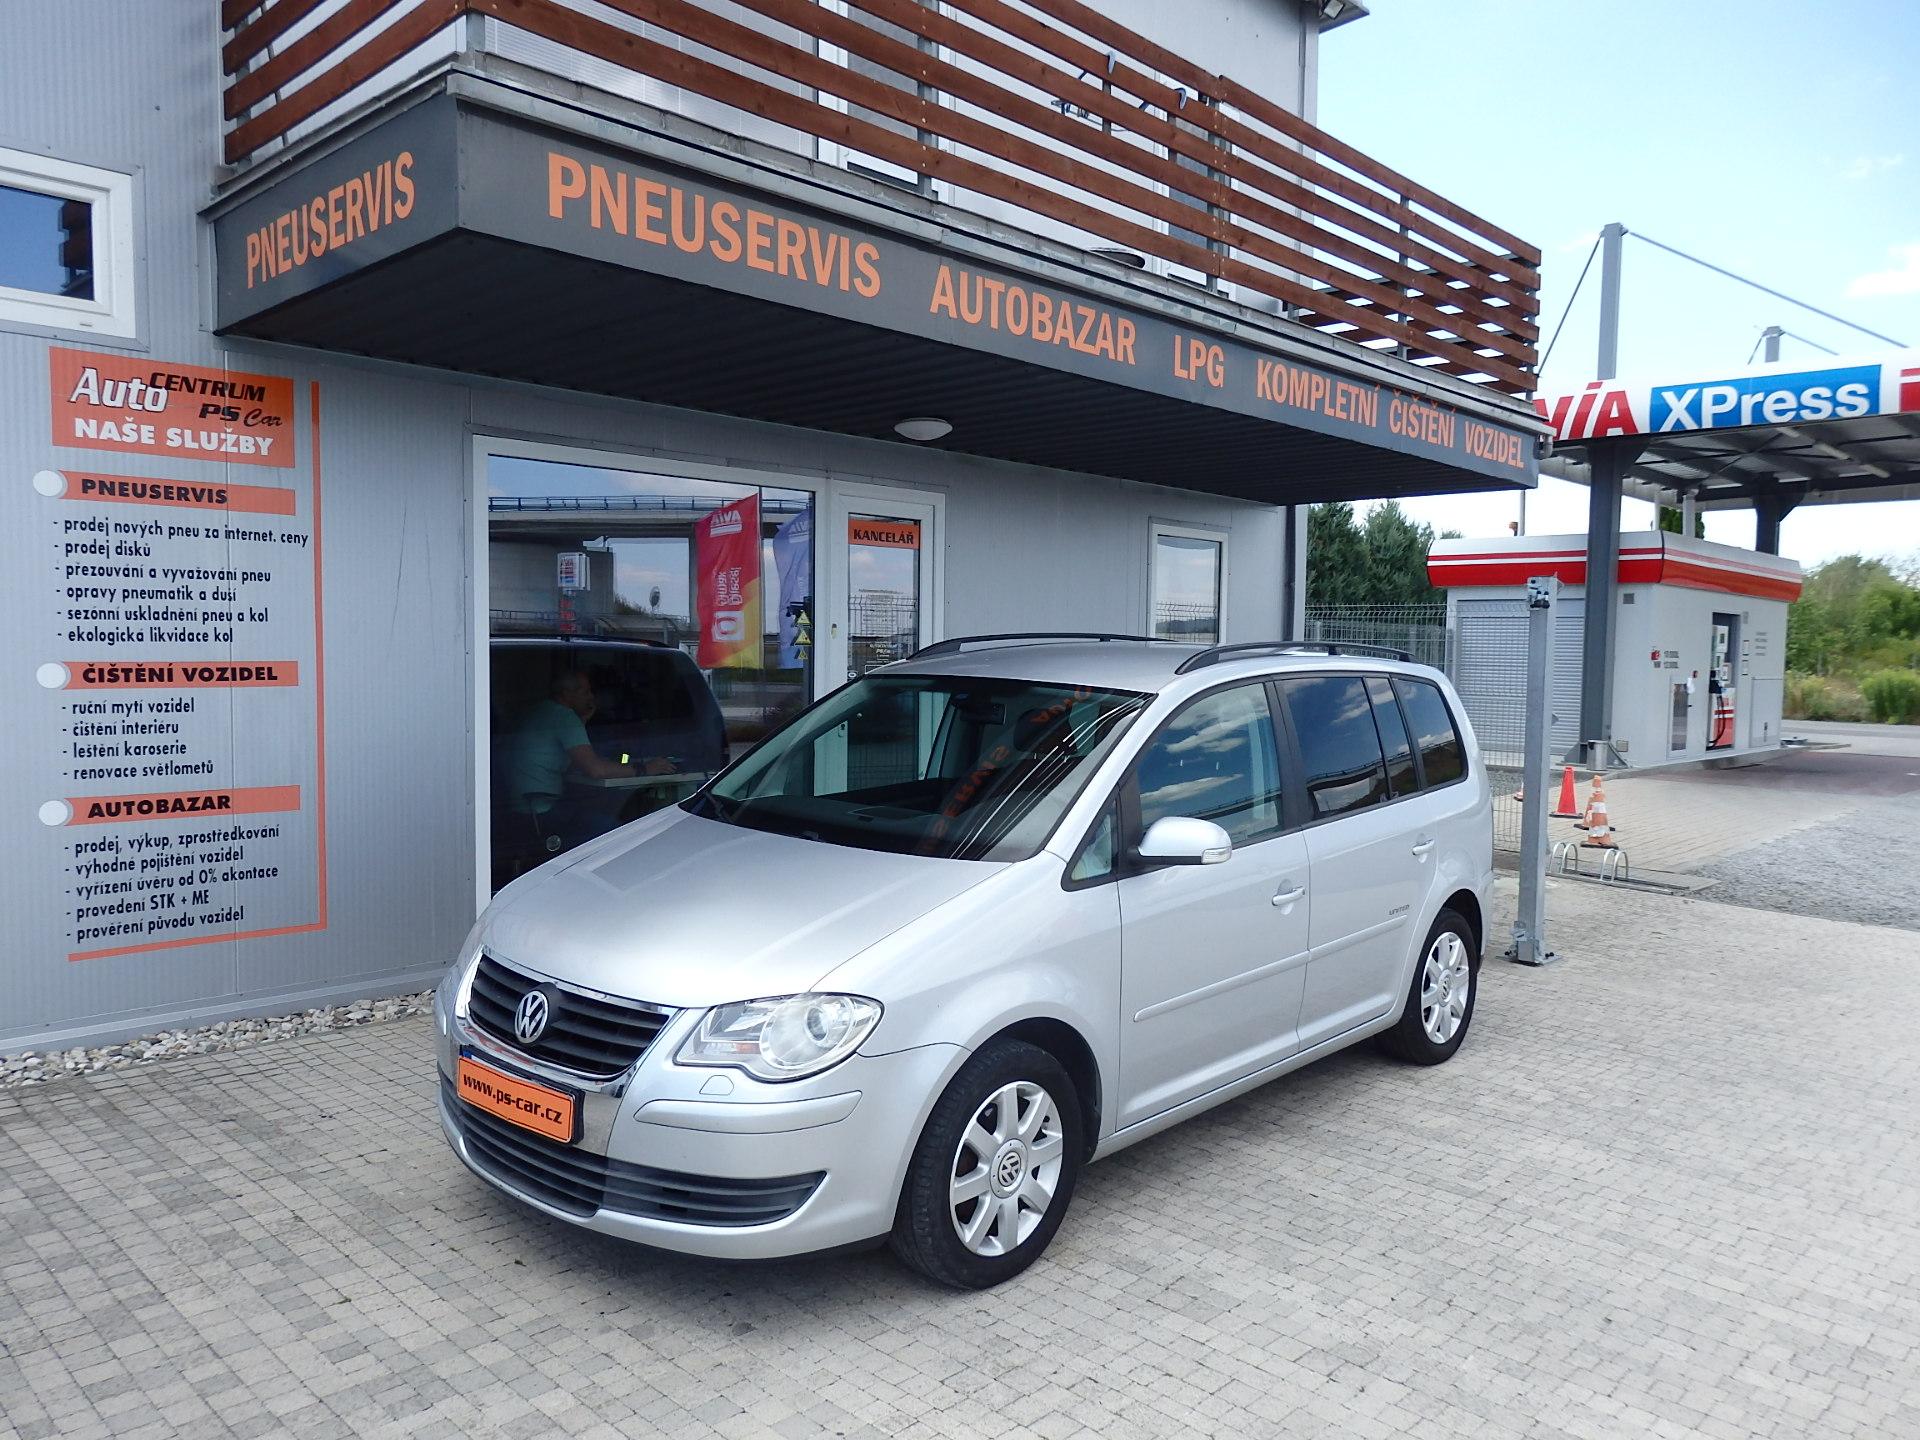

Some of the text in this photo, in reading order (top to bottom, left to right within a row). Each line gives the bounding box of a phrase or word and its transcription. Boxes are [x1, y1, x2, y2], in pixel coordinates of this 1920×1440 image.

[246, 151, 415, 289] PNEUSERVIS
[548, 152, 1524, 468] PNEUSERVIS AUTOBAZAR LPG KOMPLETNÍ ČIŠTĚNÍ VOZIDEL
[68, 366, 266, 413] Auto CENTRUM
[198, 403, 283, 427] PS Car
[1659, 383, 1869, 432] XPress
[75, 416, 274, 455] NAŠE SLUŽBY
[82, 478, 227, 504] PNEUSERVIS
[64, 516, 308, 547] prodej nových pneu za internet. ceny
[853, 529, 914, 544] KANCELÁŘ
[65, 539, 151, 559] prodej disků
[66, 562, 271, 584] přezouvání a vyvažování pneu
[66, 585, 236, 602] opravy pneumatik a duší
[67, 605, 268, 625] sezónní uskladnění pneu a kol
[68, 626, 233, 645] ekologická likvidace kol
[82, 663, 278, 683] ČIŠTĚNÍ VOZIDEL
[72, 698, 195, 717] ruční mytí vozidel
[73, 719, 179, 736] čištění interiéru
[73, 740, 186, 758] leštění karoserie
[74, 760, 213, 779] renovace světlometů
[88, 795, 231, 818] AUTOBAZAR
[75, 824, 279, 857] prodej, výkup, zprostředkování
[76, 845, 244, 878] výhodné pojištění vozidel
[76, 866, 279, 900] vyřízení úvěru od 0% akontace
[77, 898, 145, 922] provedení
[150, 893, 175, 910] STK
[192, 890, 209, 906] ME
[77, 906, 244, 943] prověření původu vozidel
[463, 1074, 563, 1124] www.ps-car.cz
